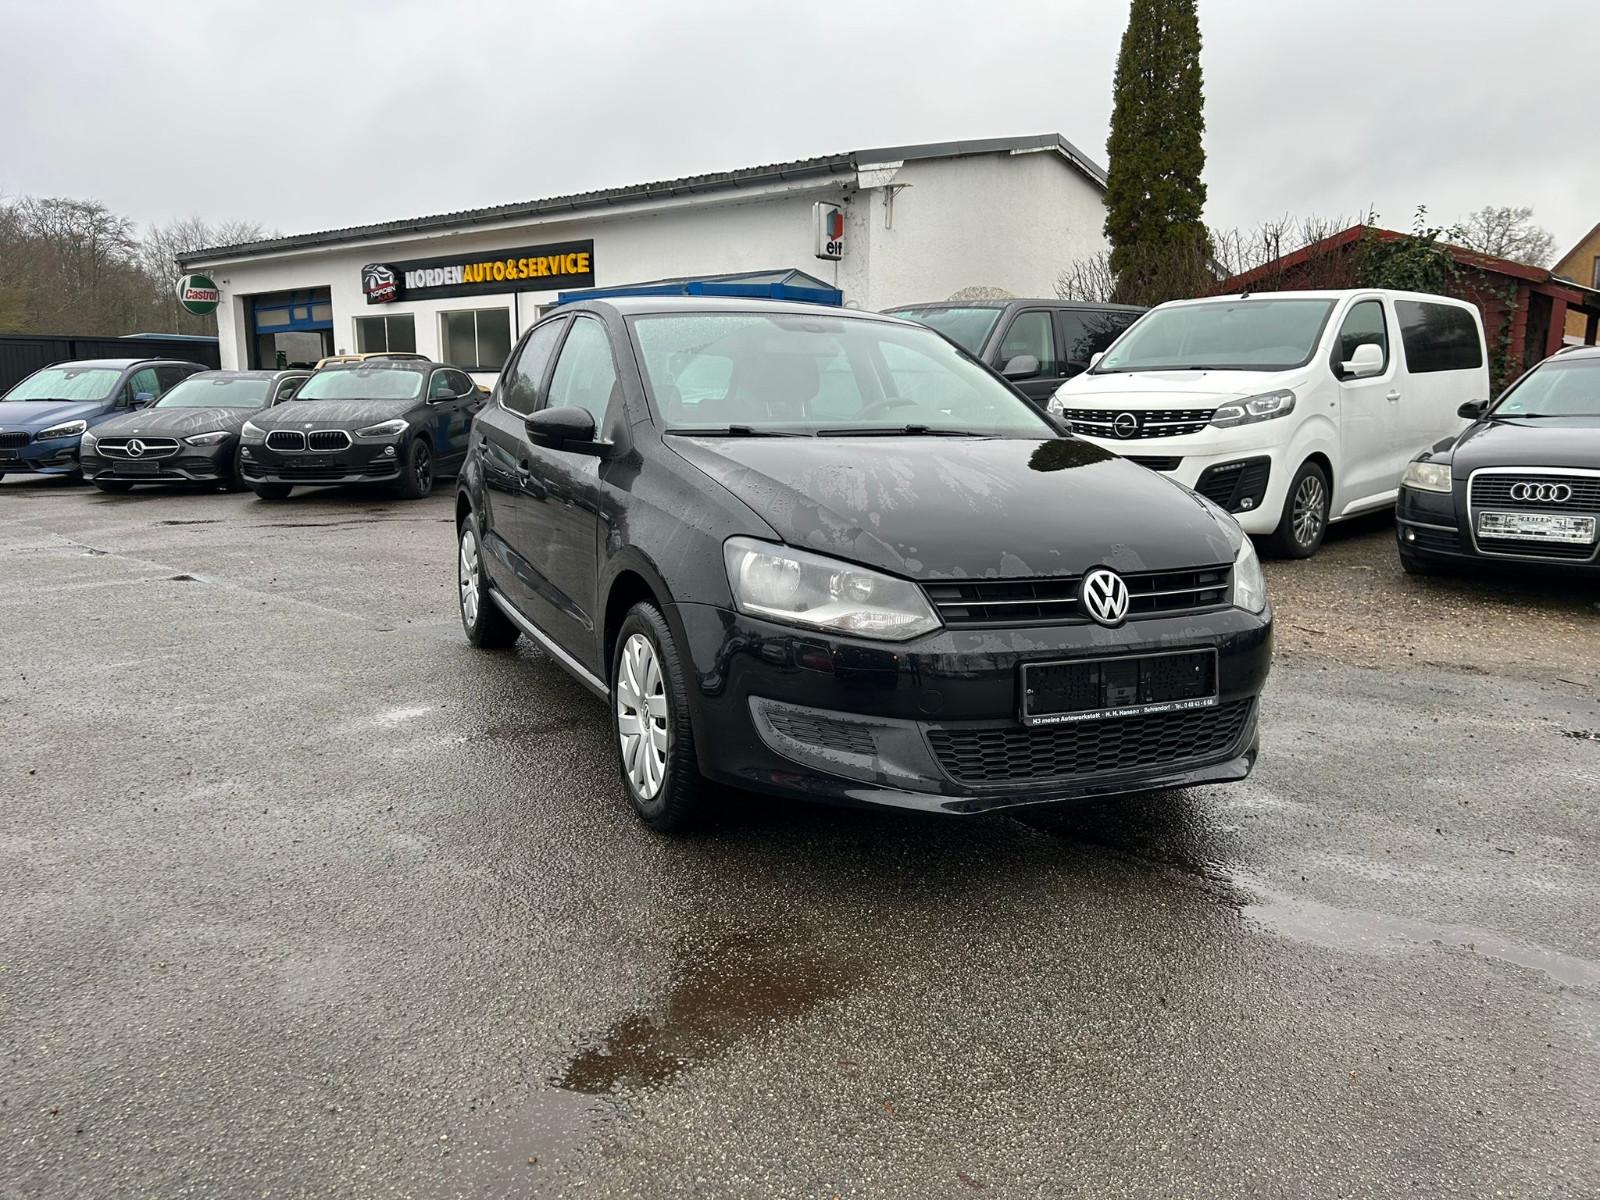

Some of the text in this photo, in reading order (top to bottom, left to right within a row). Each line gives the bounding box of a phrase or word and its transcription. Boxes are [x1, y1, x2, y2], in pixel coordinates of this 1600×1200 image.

[826, 241, 843, 255] elf
[185, 288, 218, 301] Castrol
[1060, 712, 1101, 722] Autowerkstatt
